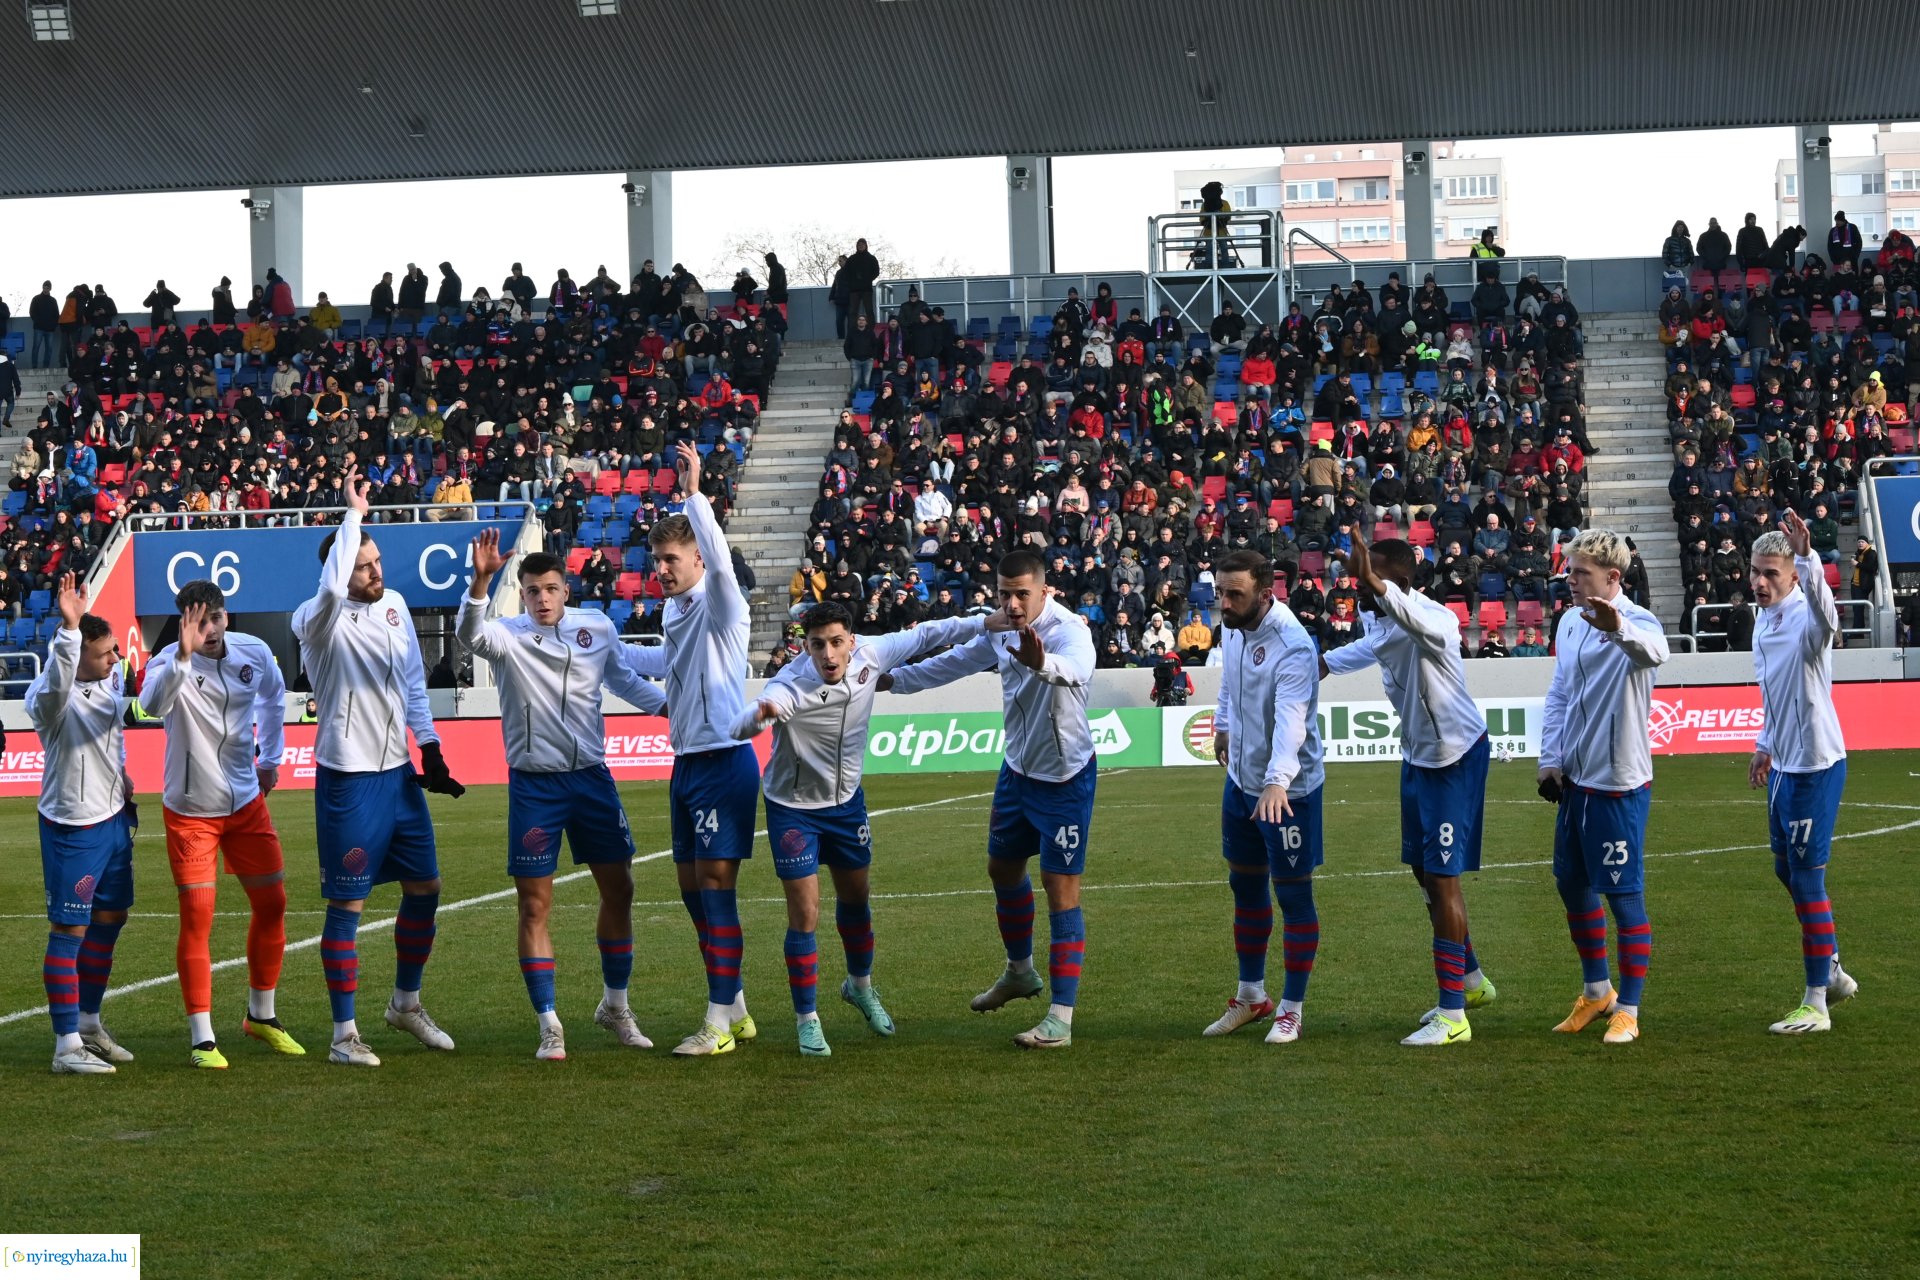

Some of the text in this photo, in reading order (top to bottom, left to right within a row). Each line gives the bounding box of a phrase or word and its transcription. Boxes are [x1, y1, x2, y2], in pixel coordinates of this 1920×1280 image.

[166, 551, 241, 597] C6
[695, 808, 719, 833] 24
[1788, 818, 1813, 845] 77
[1054, 825, 1080, 849] 45
[1278, 825, 1302, 850] 16
[1439, 822, 1454, 847] 8
[1602, 840, 1629, 866] 23
